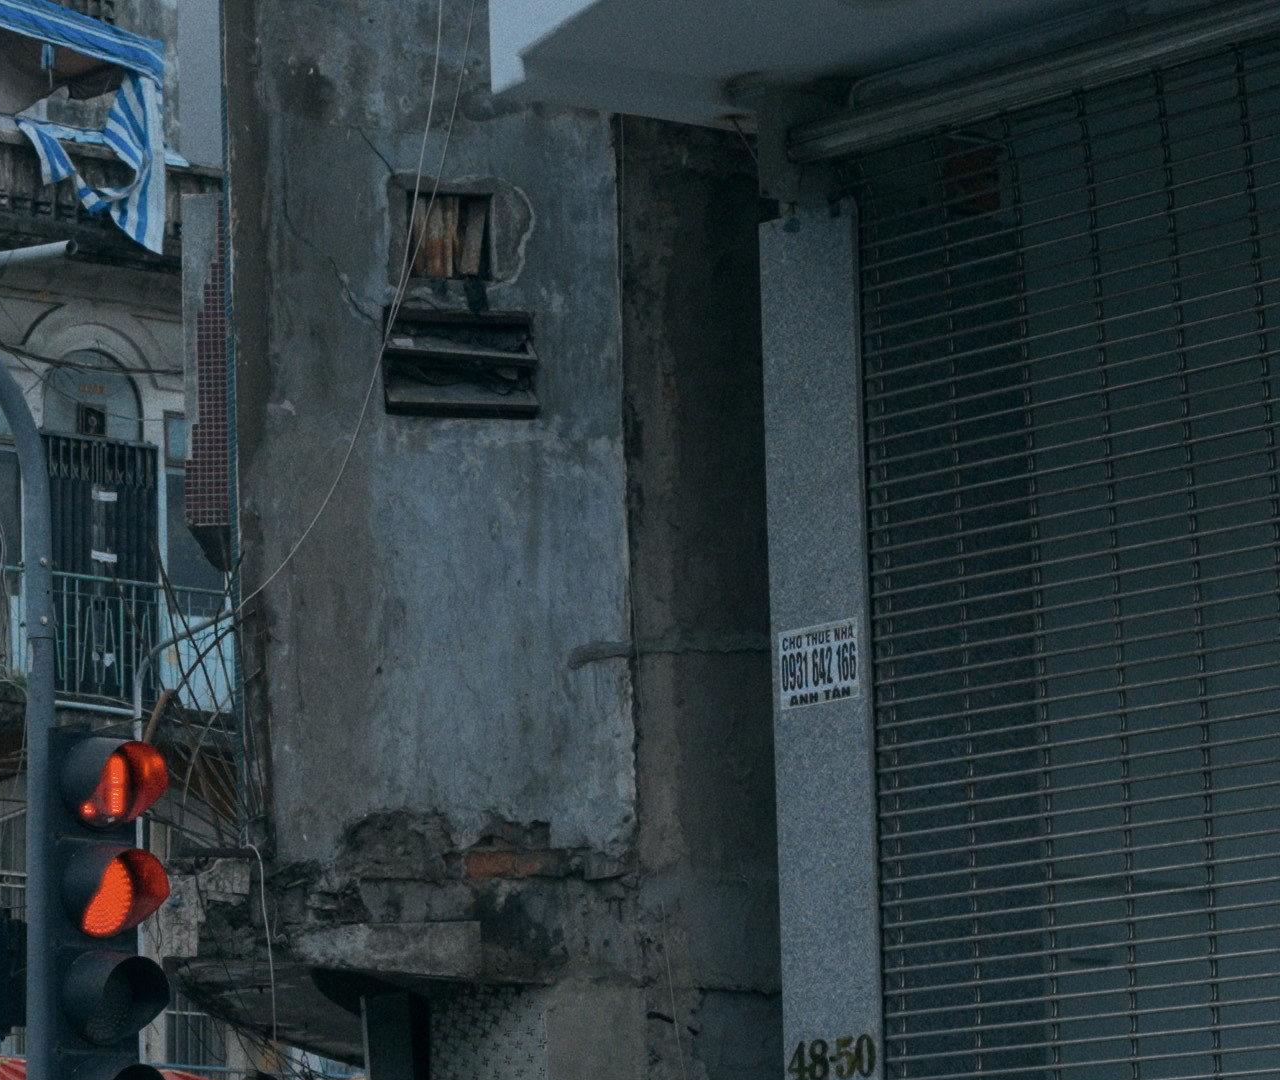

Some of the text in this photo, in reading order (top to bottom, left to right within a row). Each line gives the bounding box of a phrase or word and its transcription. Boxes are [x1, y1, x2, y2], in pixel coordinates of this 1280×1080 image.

[782, 635, 802, 651] CHO
[782, 641, 856, 692] 0931 642 166
[790, 692, 819, 707] ANH
